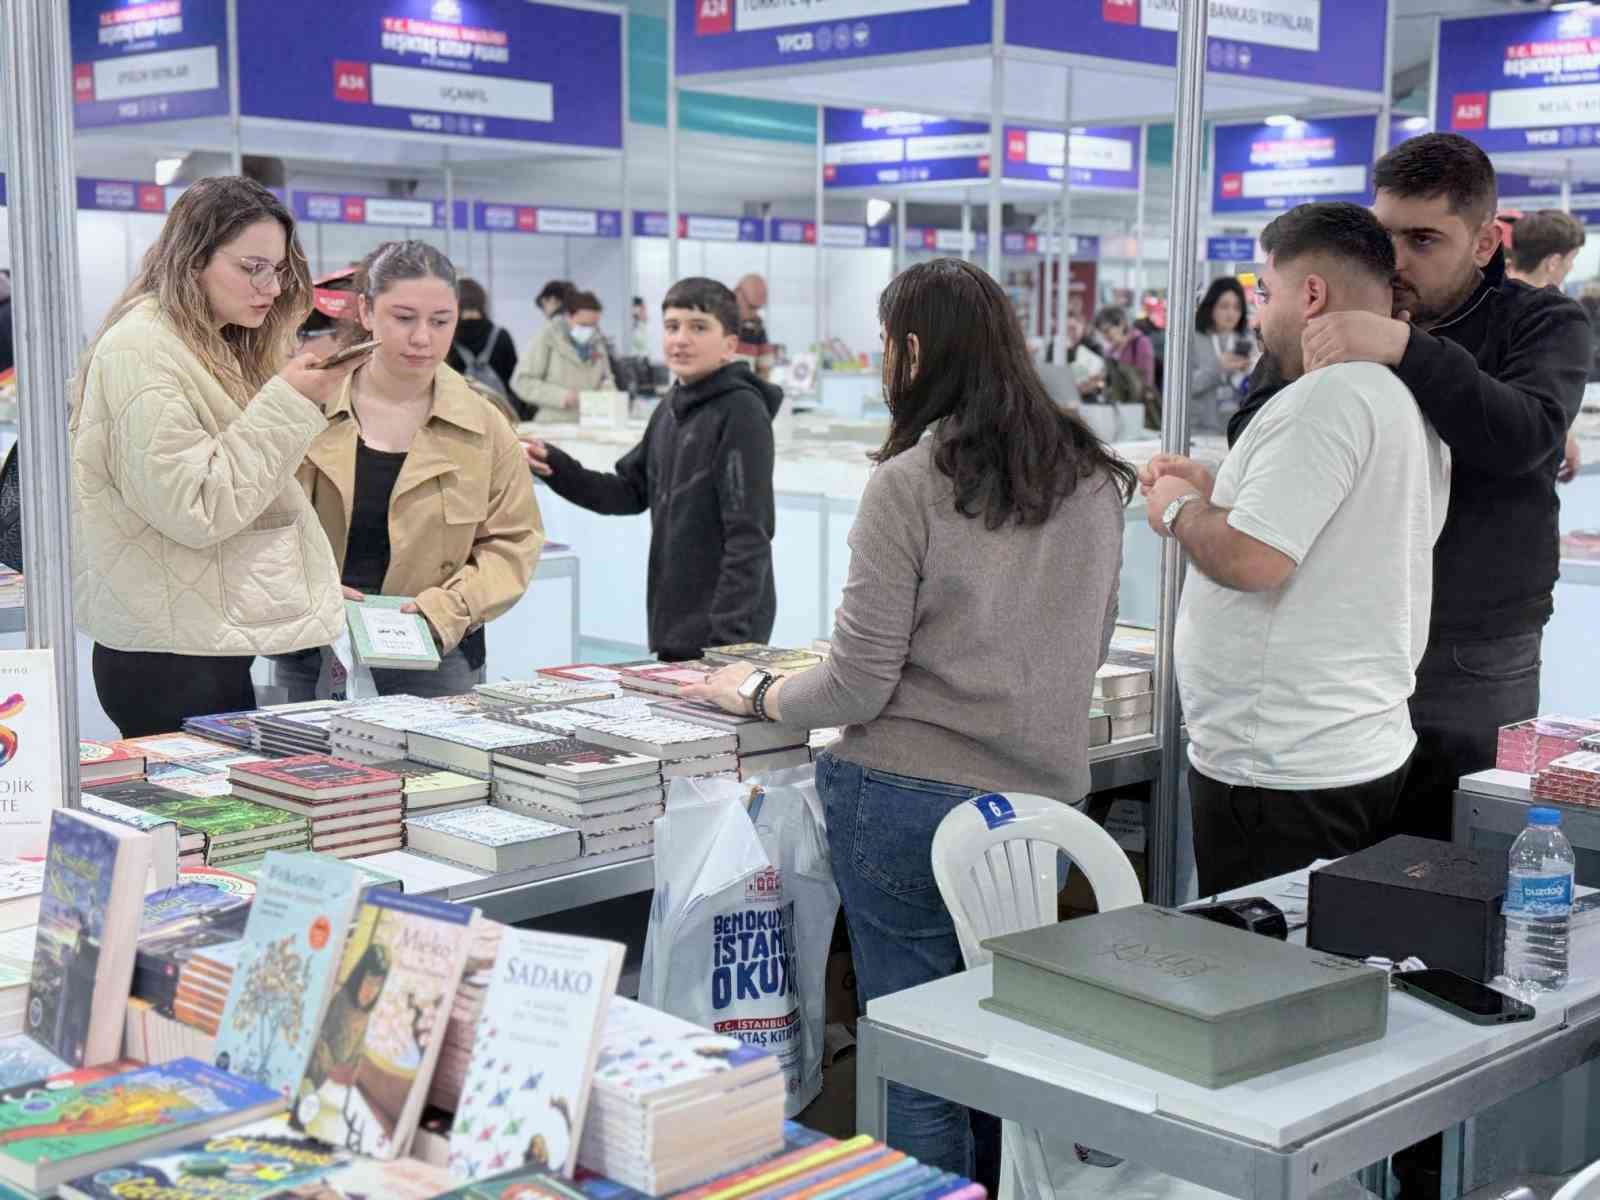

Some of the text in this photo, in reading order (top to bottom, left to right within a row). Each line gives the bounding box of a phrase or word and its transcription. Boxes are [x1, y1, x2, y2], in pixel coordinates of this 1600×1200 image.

[1209, 3, 1257, 22] BANKASI
[1260, 9, 1313, 33] YAYINLARI
[338, 74, 366, 90] A34
[988, 801, 1002, 817] 6
[714, 929, 794, 967] İSTAN
[503, 956, 592, 994] SADAKO
[712, 954, 798, 1009] OKUY
